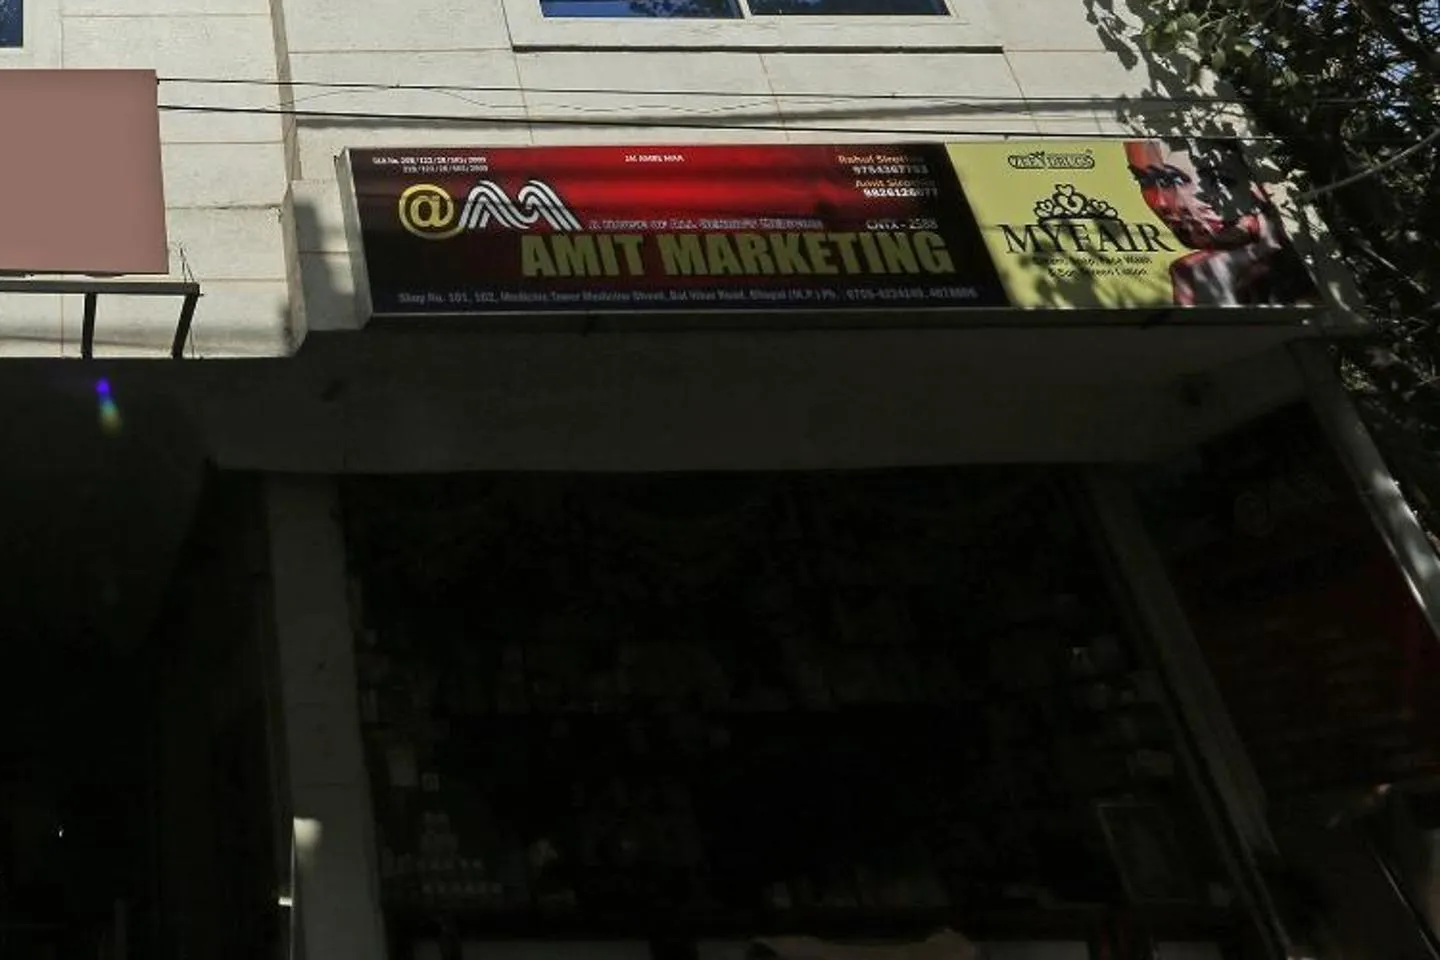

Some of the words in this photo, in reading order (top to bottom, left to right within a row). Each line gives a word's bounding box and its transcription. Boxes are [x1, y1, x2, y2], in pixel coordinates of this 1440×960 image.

[520, 233, 646, 277] AMIT
[659, 231, 956, 276] MARKETING
[997, 223, 1176, 253] MYFAIR
